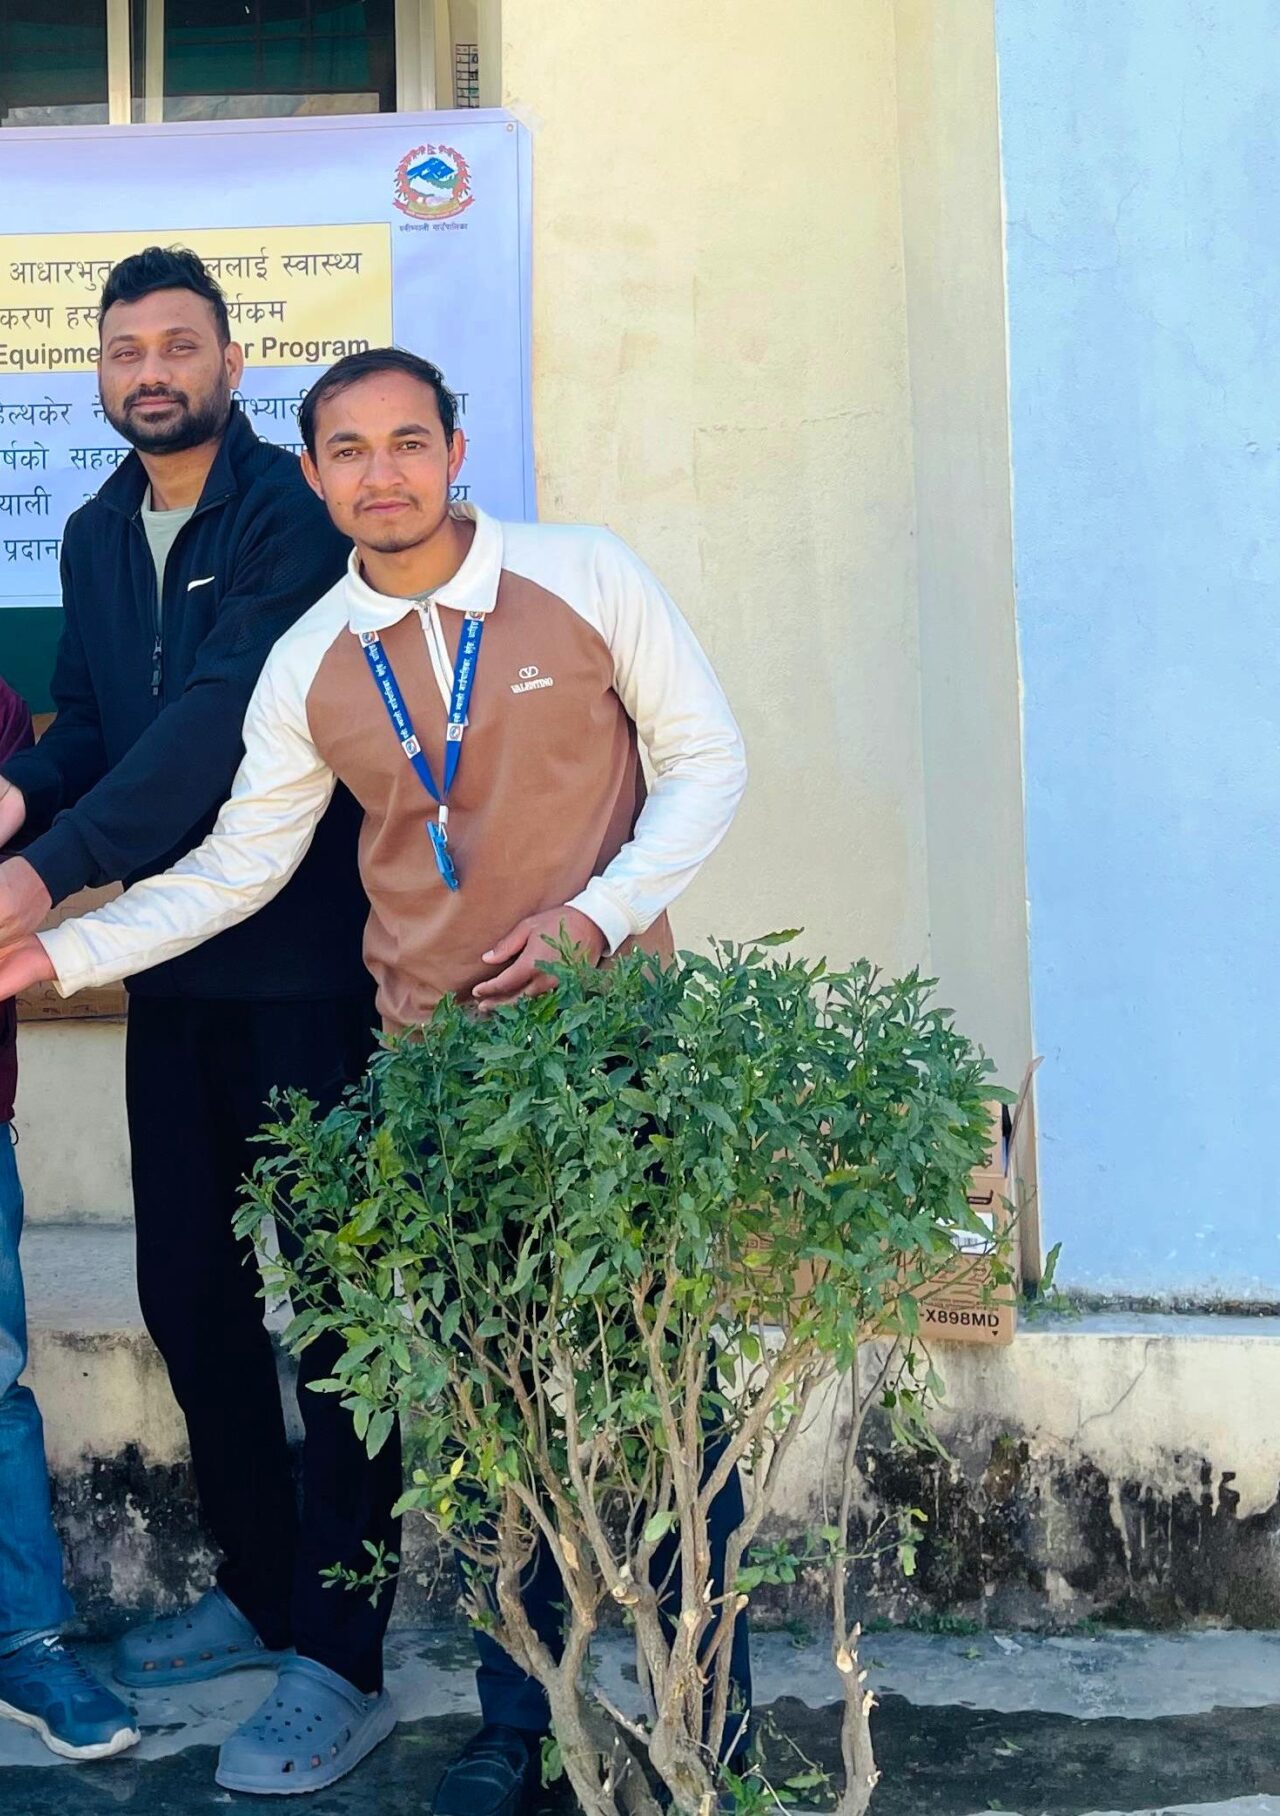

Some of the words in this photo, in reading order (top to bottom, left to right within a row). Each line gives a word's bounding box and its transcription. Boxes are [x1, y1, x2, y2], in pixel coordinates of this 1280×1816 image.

[281, 252, 363, 277] स्वास्थ्य
[261, 336, 370, 362] Program
[920, 1309, 1000, 1328] -X898MD
